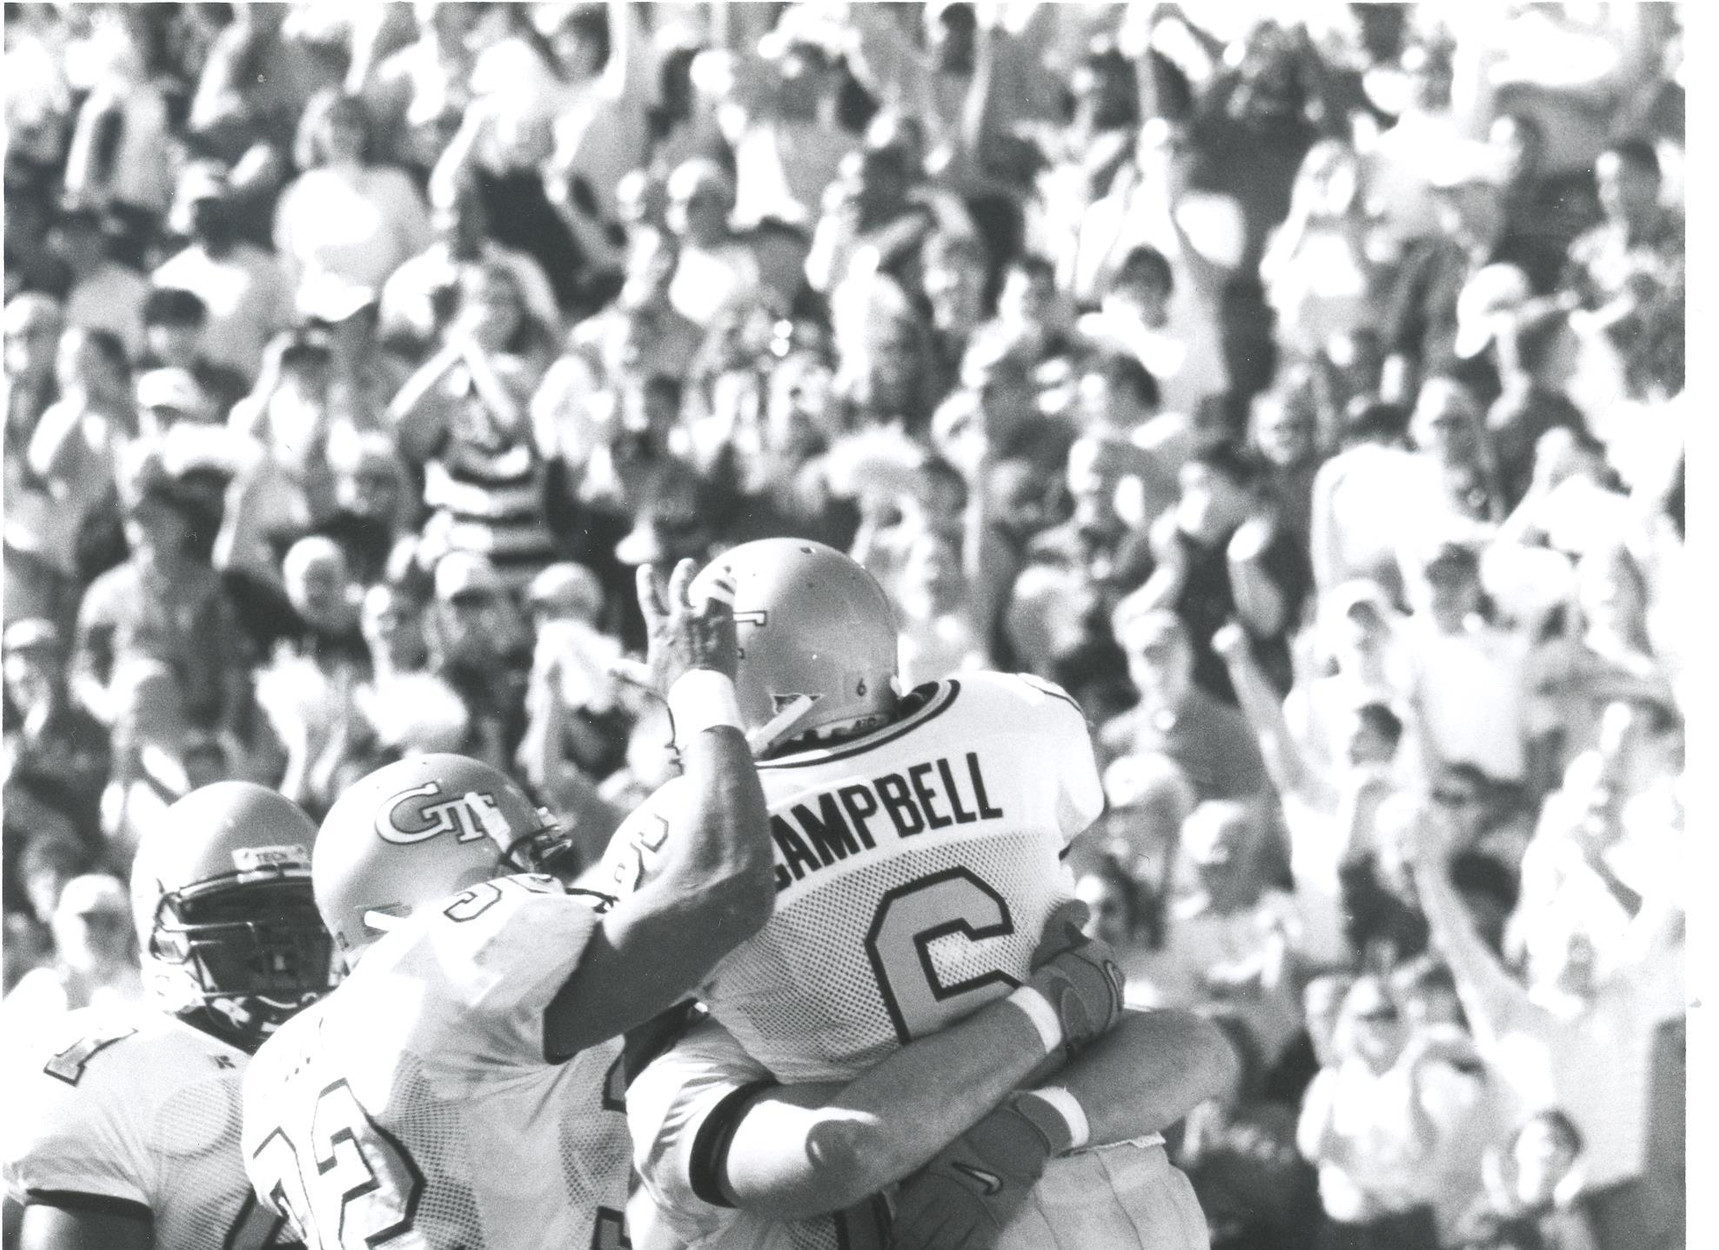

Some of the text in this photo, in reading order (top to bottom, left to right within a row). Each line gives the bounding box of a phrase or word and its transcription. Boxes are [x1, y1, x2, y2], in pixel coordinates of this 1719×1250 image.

[855, 677, 868, 698] 6
[374, 780, 495, 847] GT
[770, 751, 1004, 894] AMPBELL
[863, 864, 1025, 1047] 6
